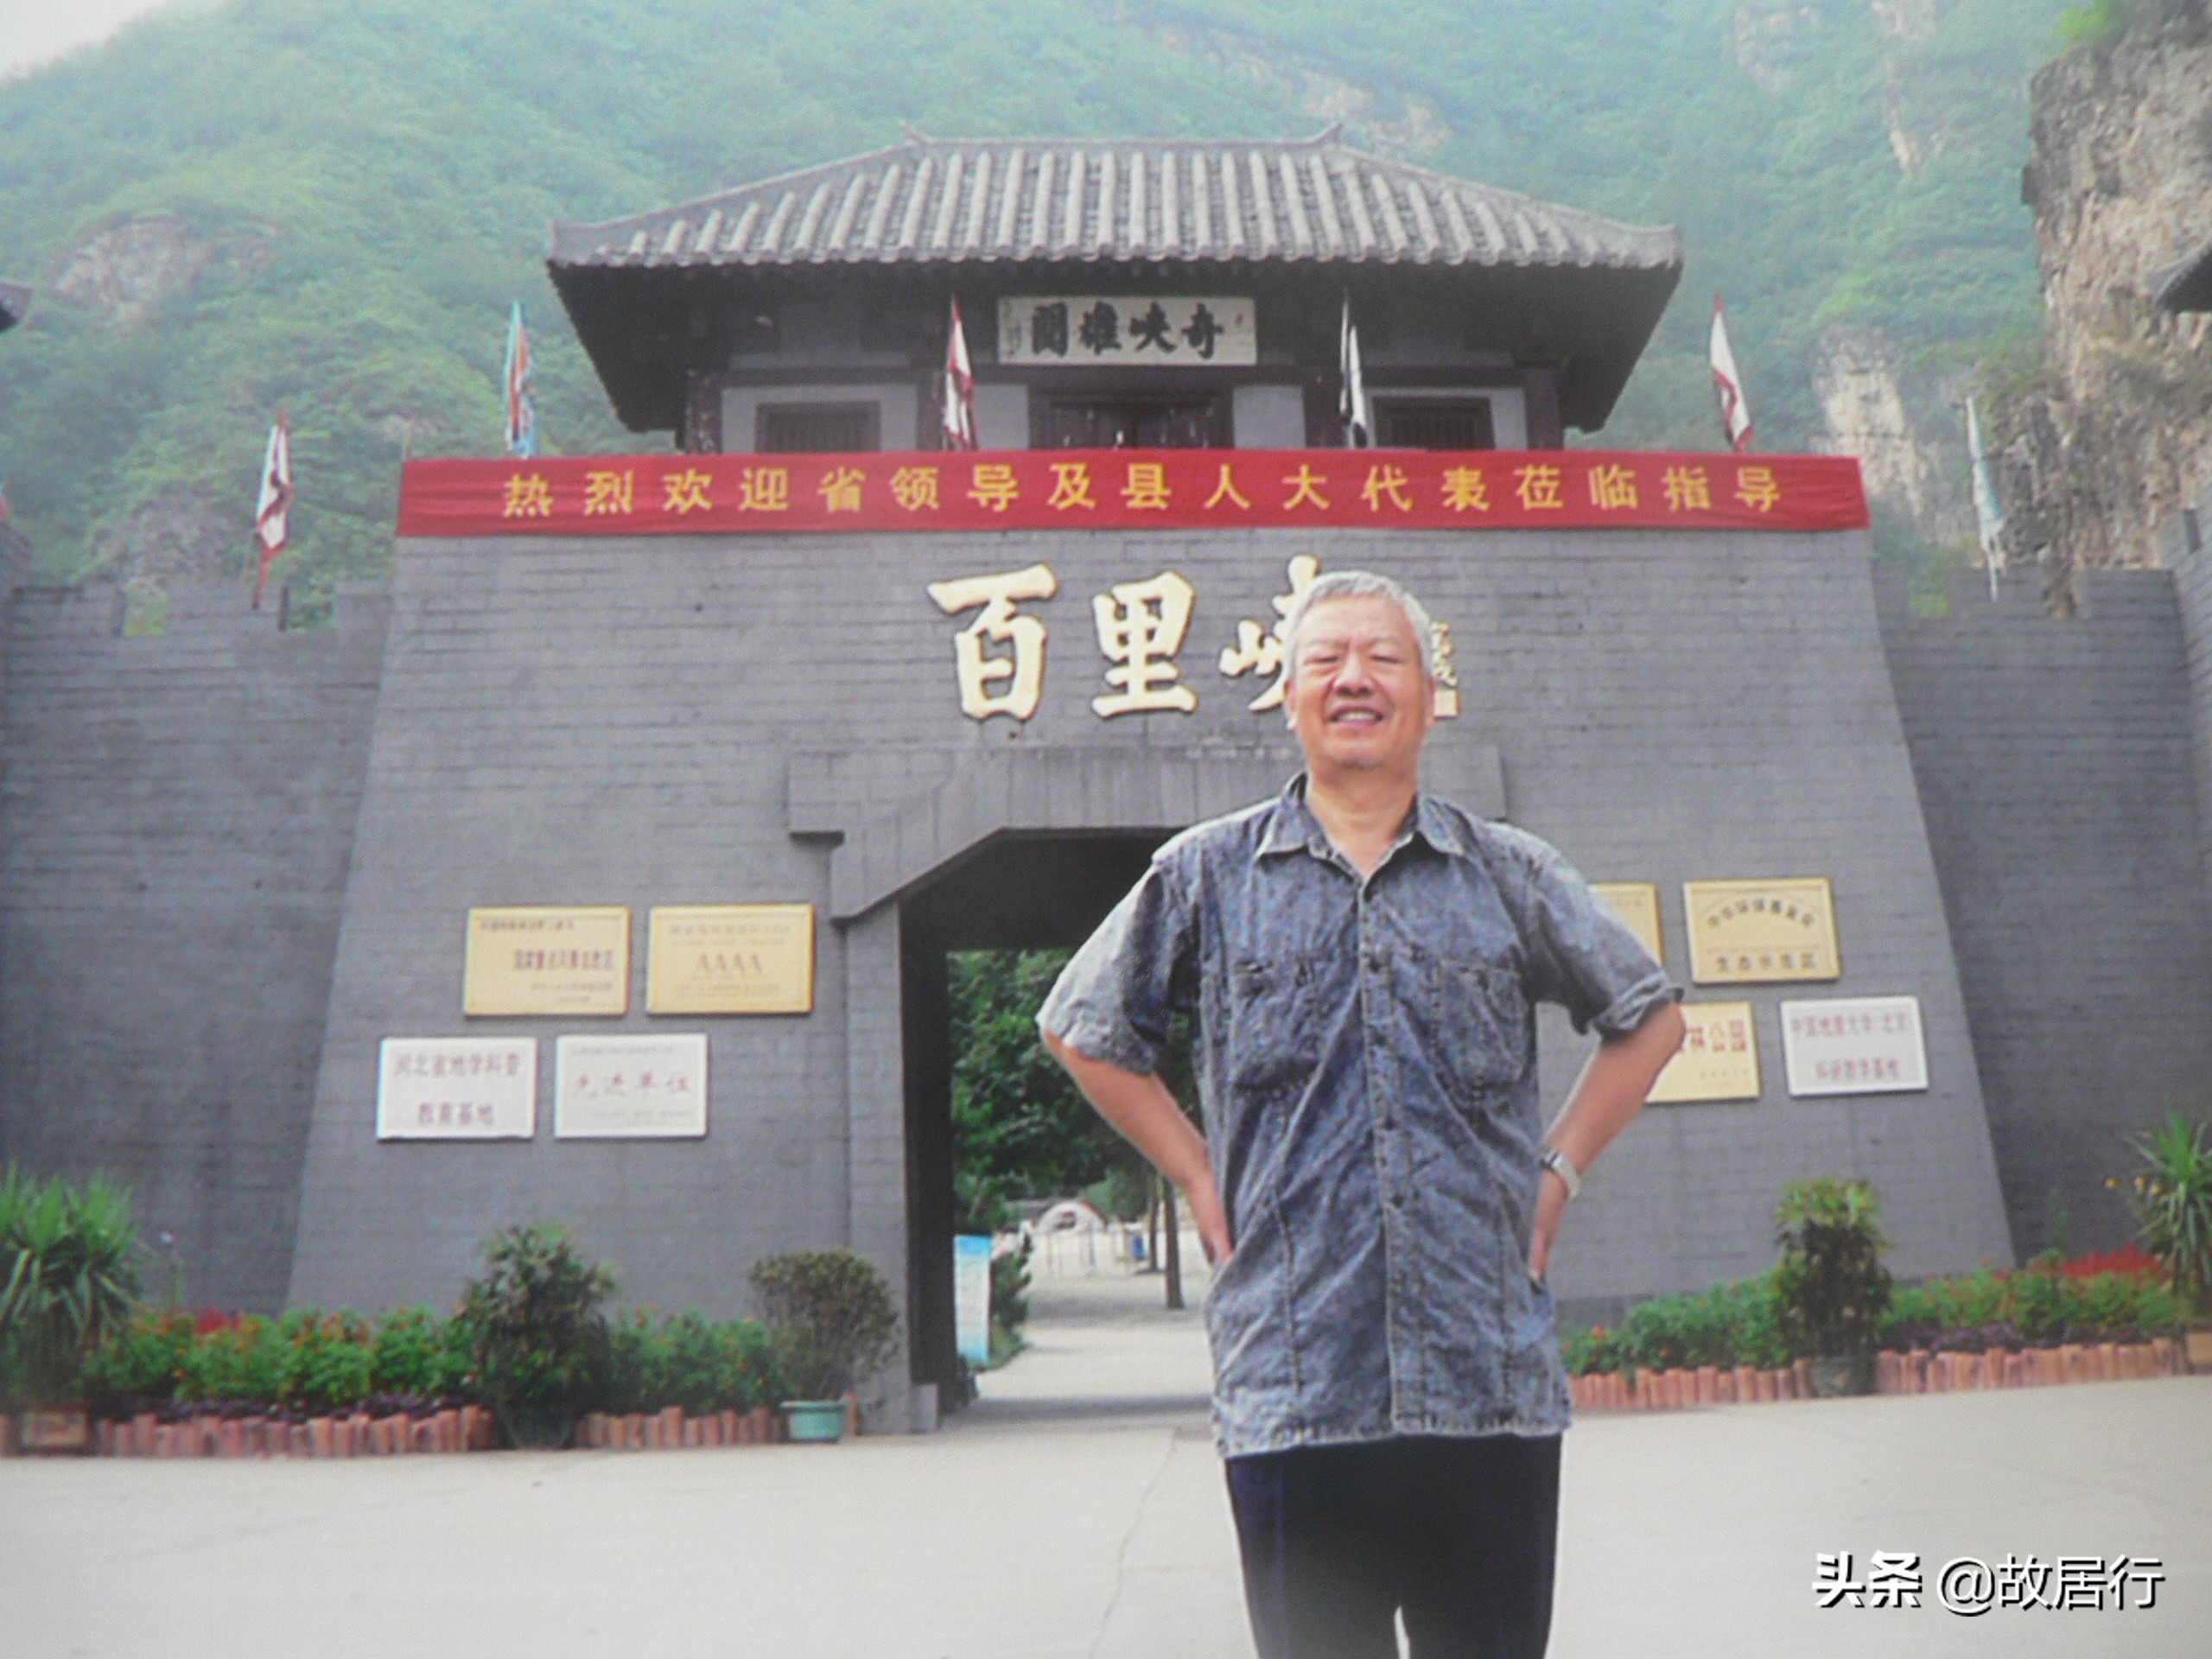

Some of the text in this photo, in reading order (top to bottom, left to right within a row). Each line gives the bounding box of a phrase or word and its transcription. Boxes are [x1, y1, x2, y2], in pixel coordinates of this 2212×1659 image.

[503, 463, 1781, 518] 热烈欢迎省领导及县人大代表莅临指导
